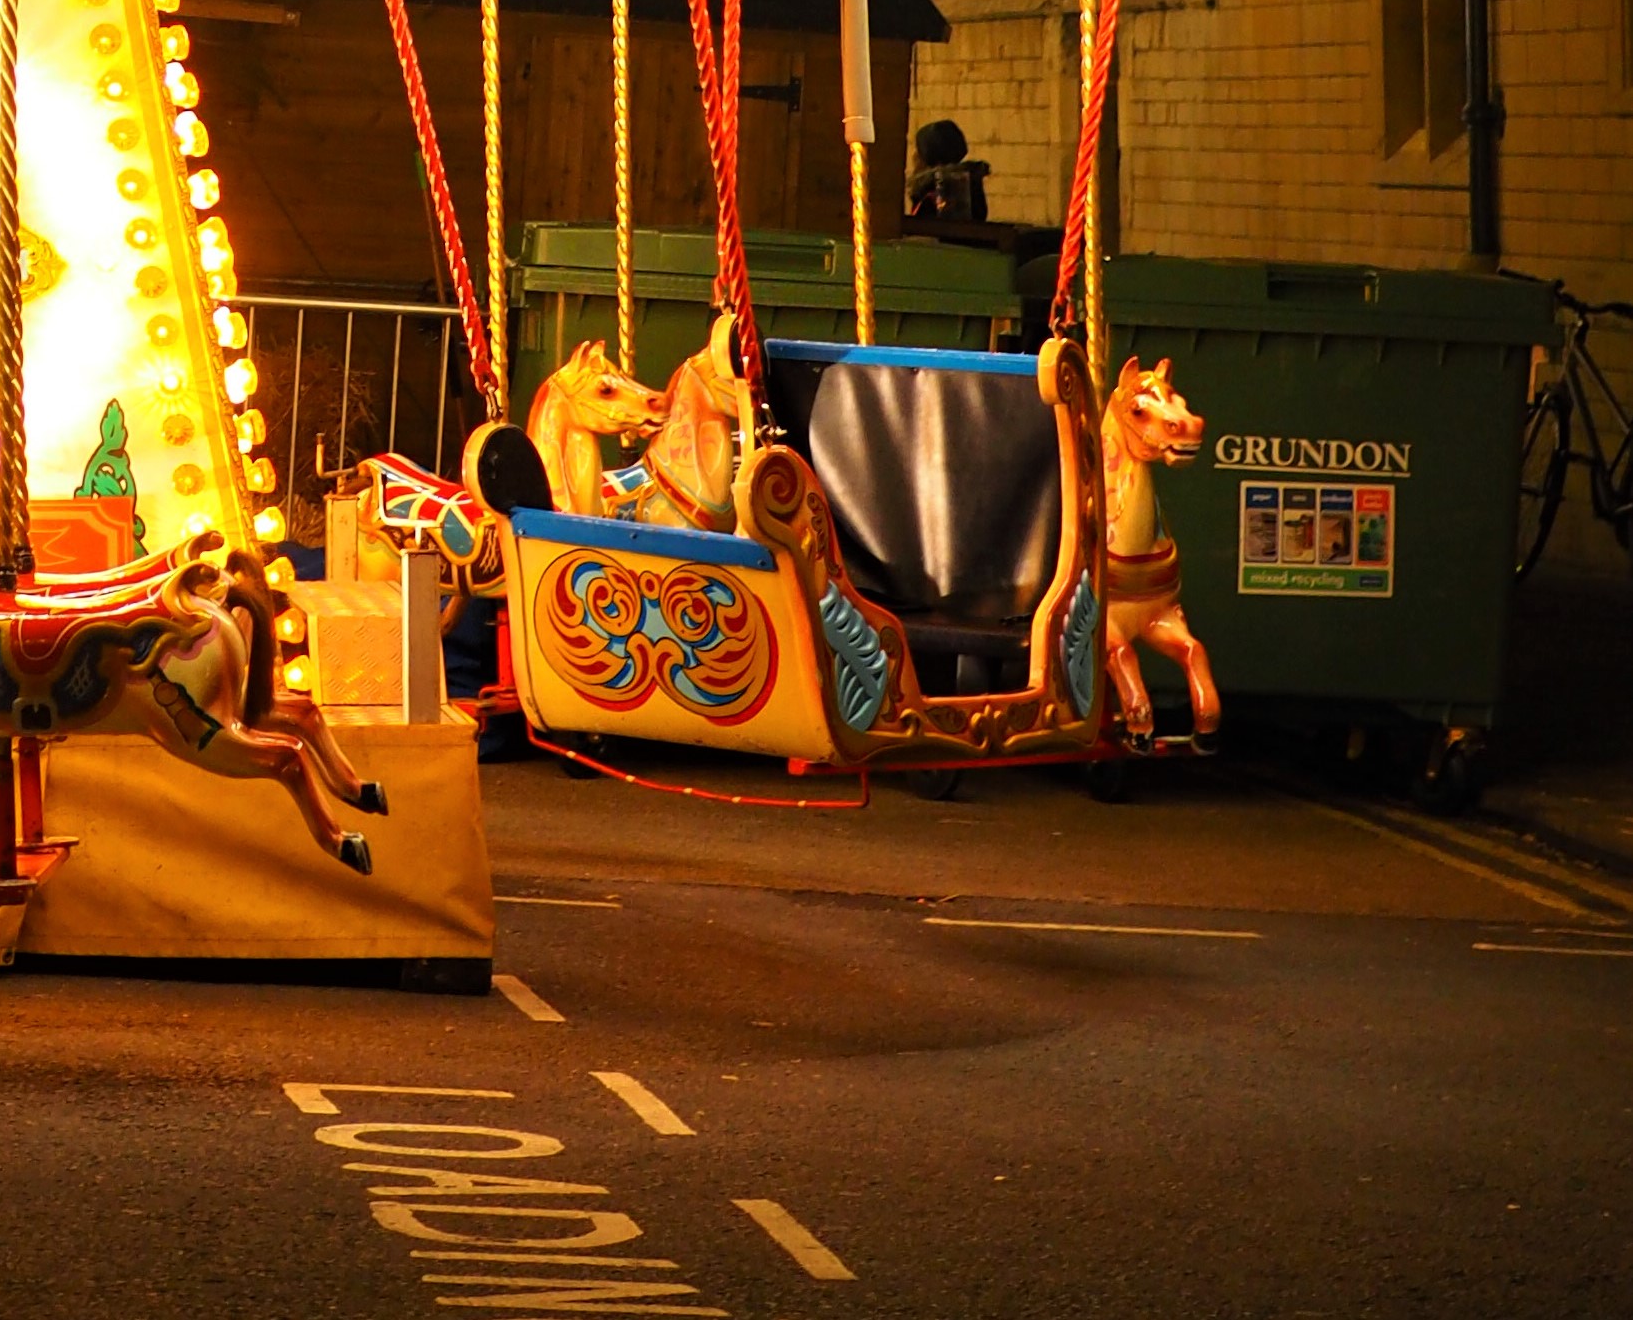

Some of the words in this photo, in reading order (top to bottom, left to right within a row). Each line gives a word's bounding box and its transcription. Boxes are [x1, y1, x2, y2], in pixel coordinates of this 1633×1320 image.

[1214, 434, 1413, 473] GRUNDON
[1250, 570, 1289, 587] mixed
[1292, 571, 1345, 589] recycling
[282, 1082, 731, 1320] LOADIN
